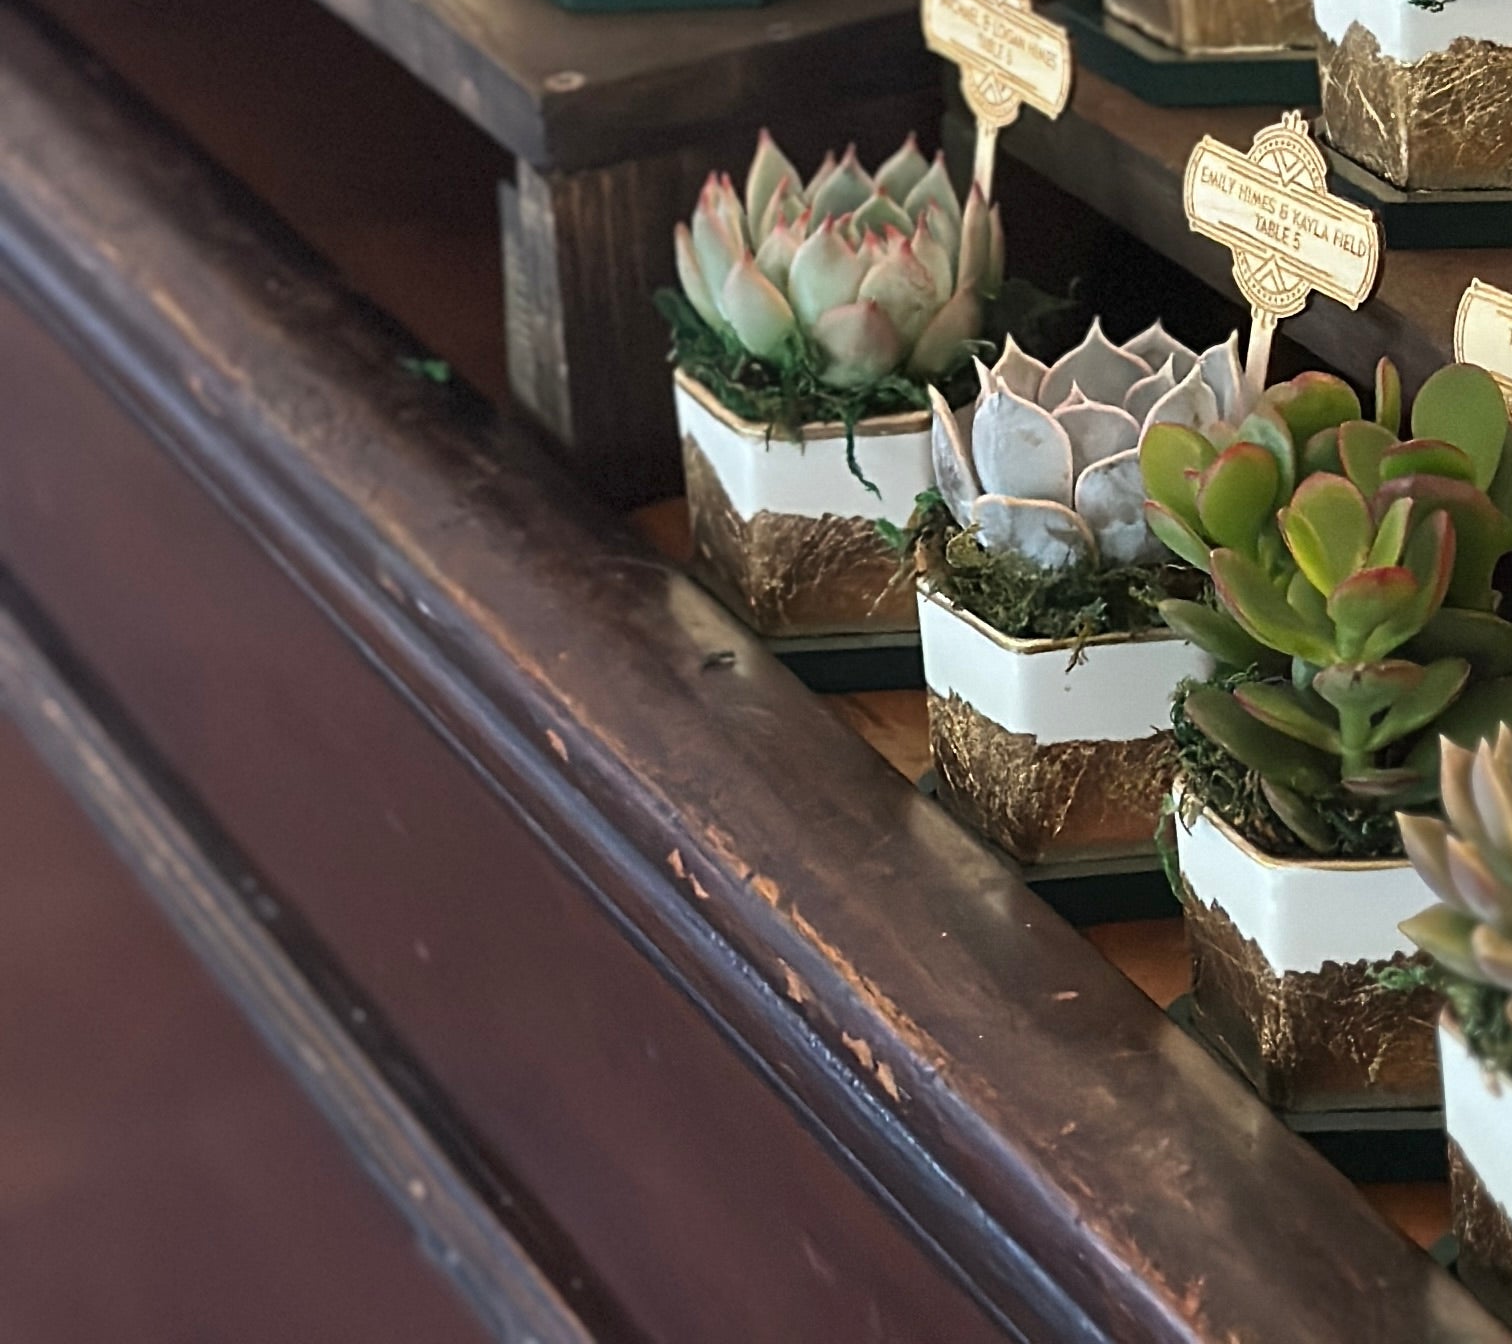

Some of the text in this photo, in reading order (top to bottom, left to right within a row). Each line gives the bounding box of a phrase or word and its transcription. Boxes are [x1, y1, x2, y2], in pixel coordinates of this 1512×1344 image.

[1201, 165, 1367, 258] EMILY HIMES & KAYLA FIELD
[1255, 214, 1301, 251] TABLE 5
